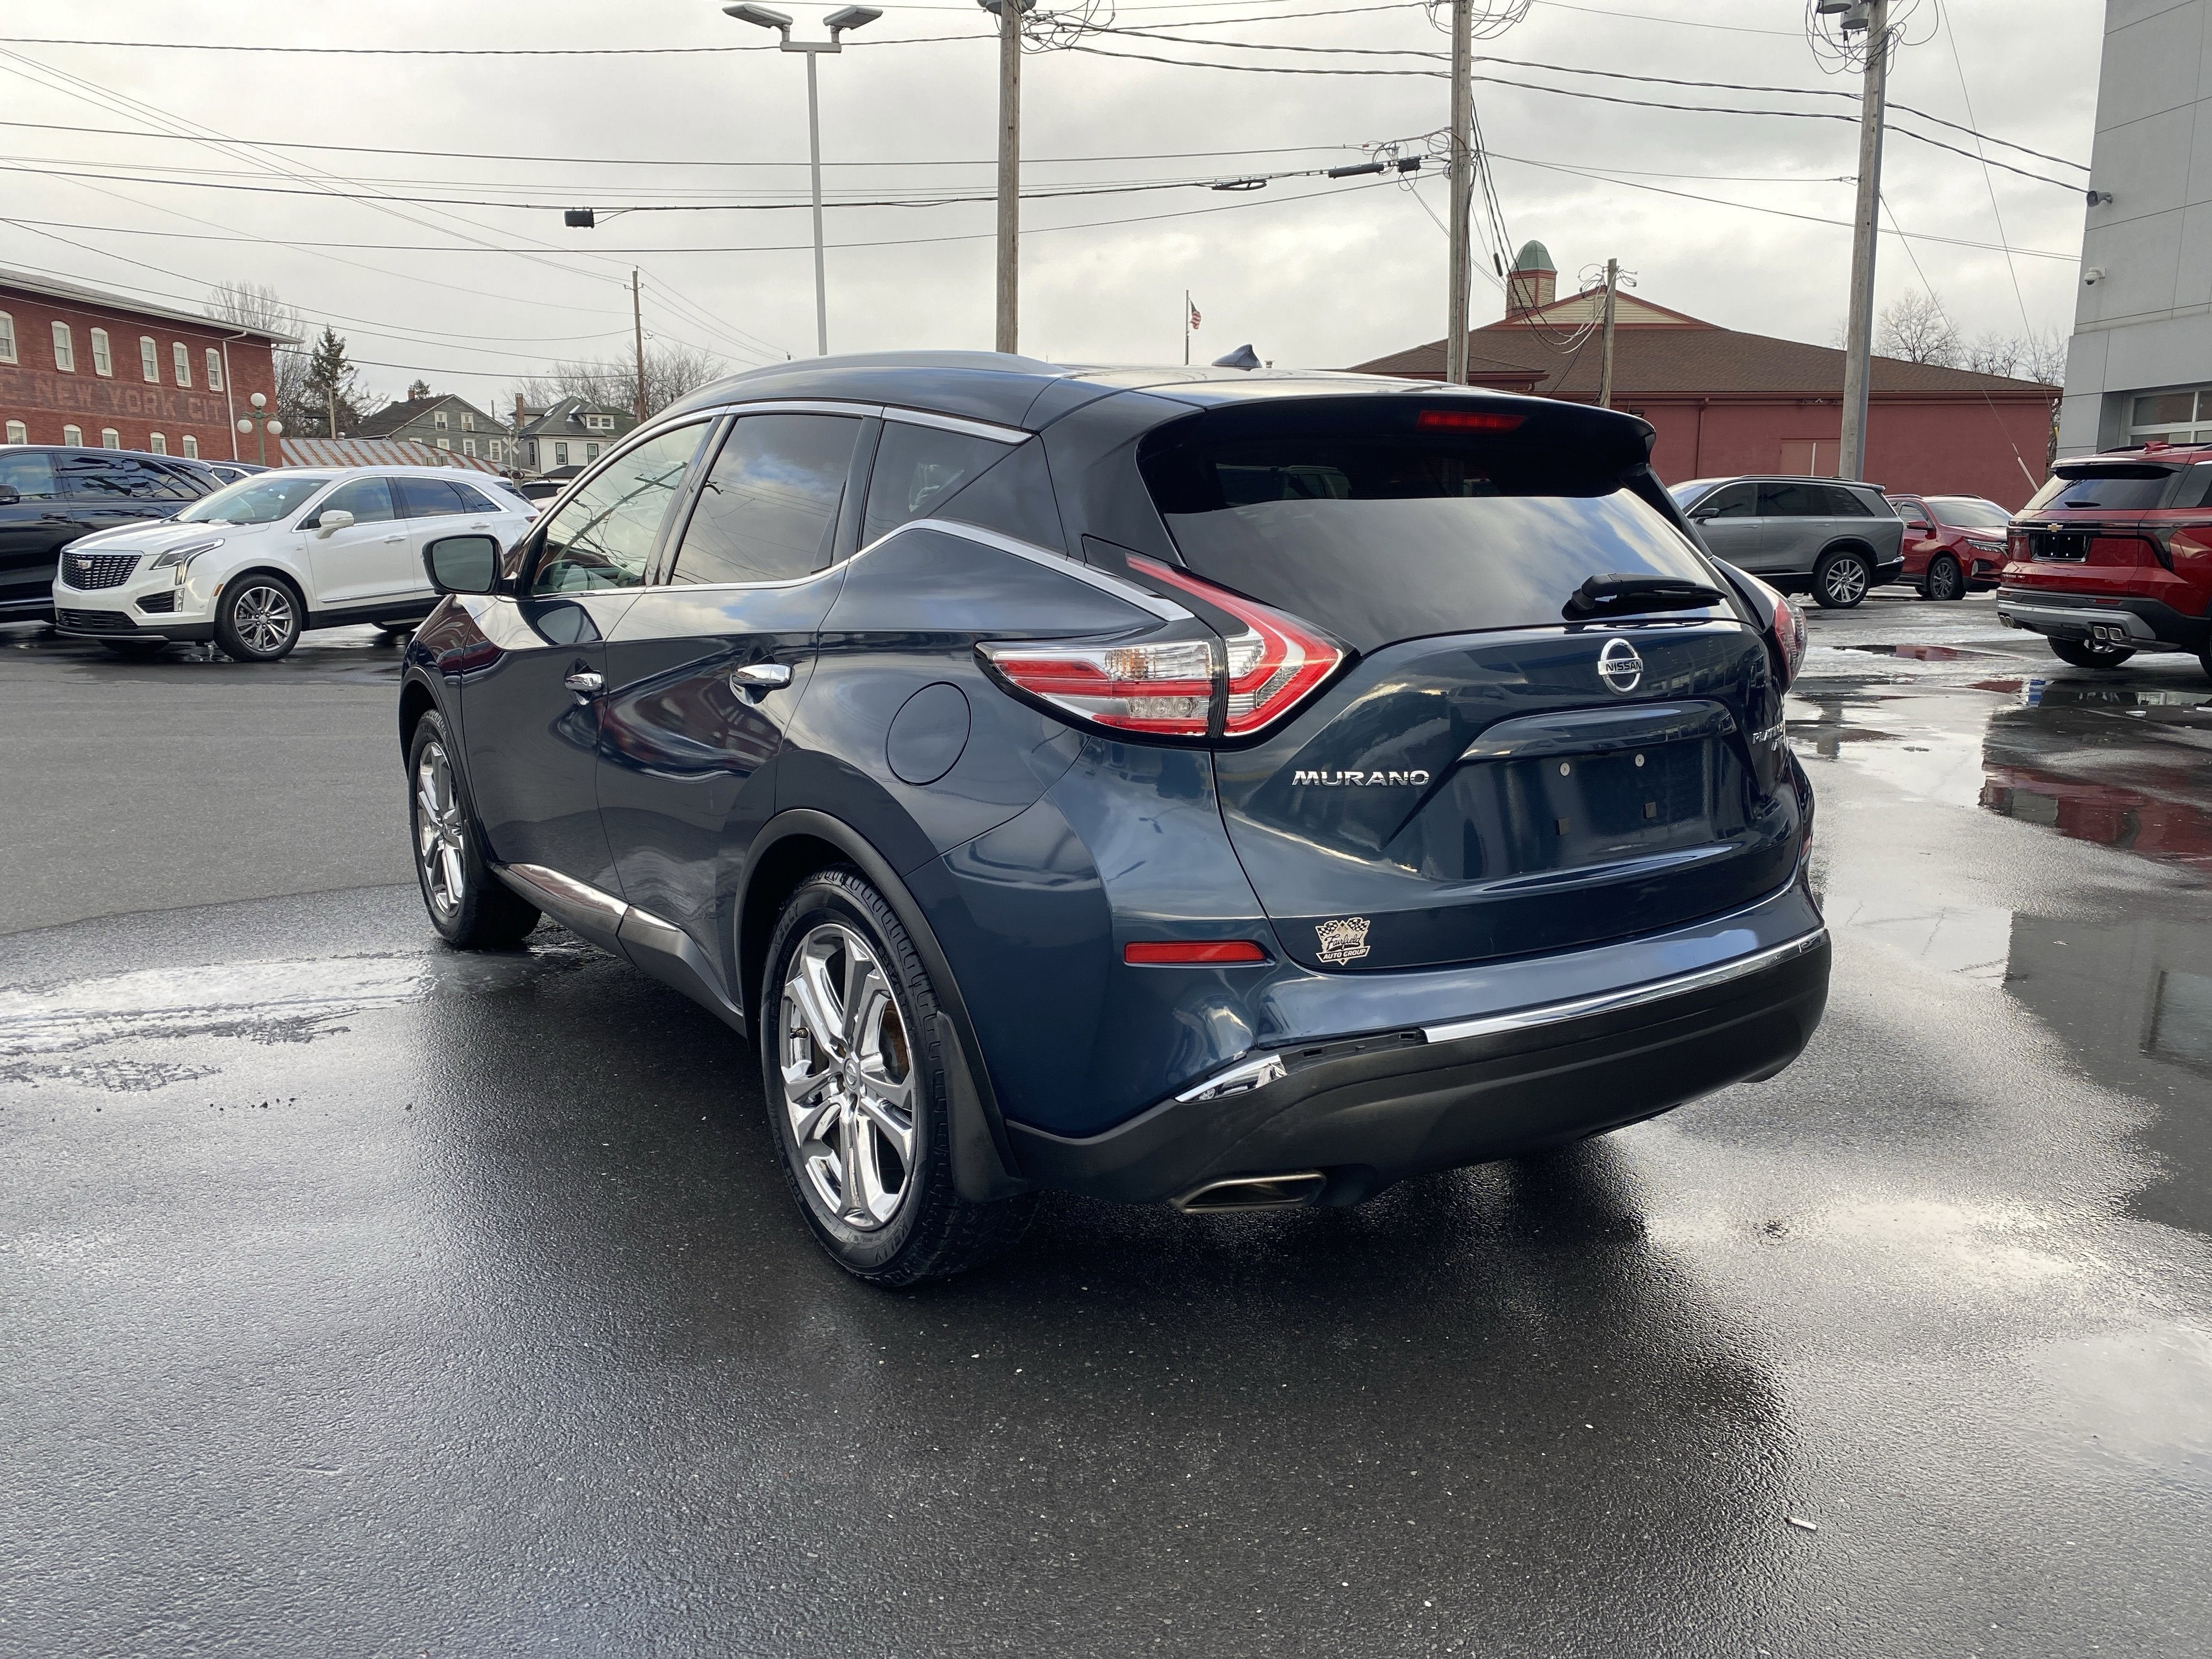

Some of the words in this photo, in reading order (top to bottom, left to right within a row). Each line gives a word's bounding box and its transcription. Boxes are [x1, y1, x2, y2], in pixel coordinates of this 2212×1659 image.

[35, 379, 92, 407] NEW
[108, 387, 176, 420] YORK
[1605, 661, 1642, 672] NISSAN
[1291, 770, 1430, 786] MURANO
[1324, 933, 1363, 951] Fairfield
[1343, 949, 1367, 957] GROUP
